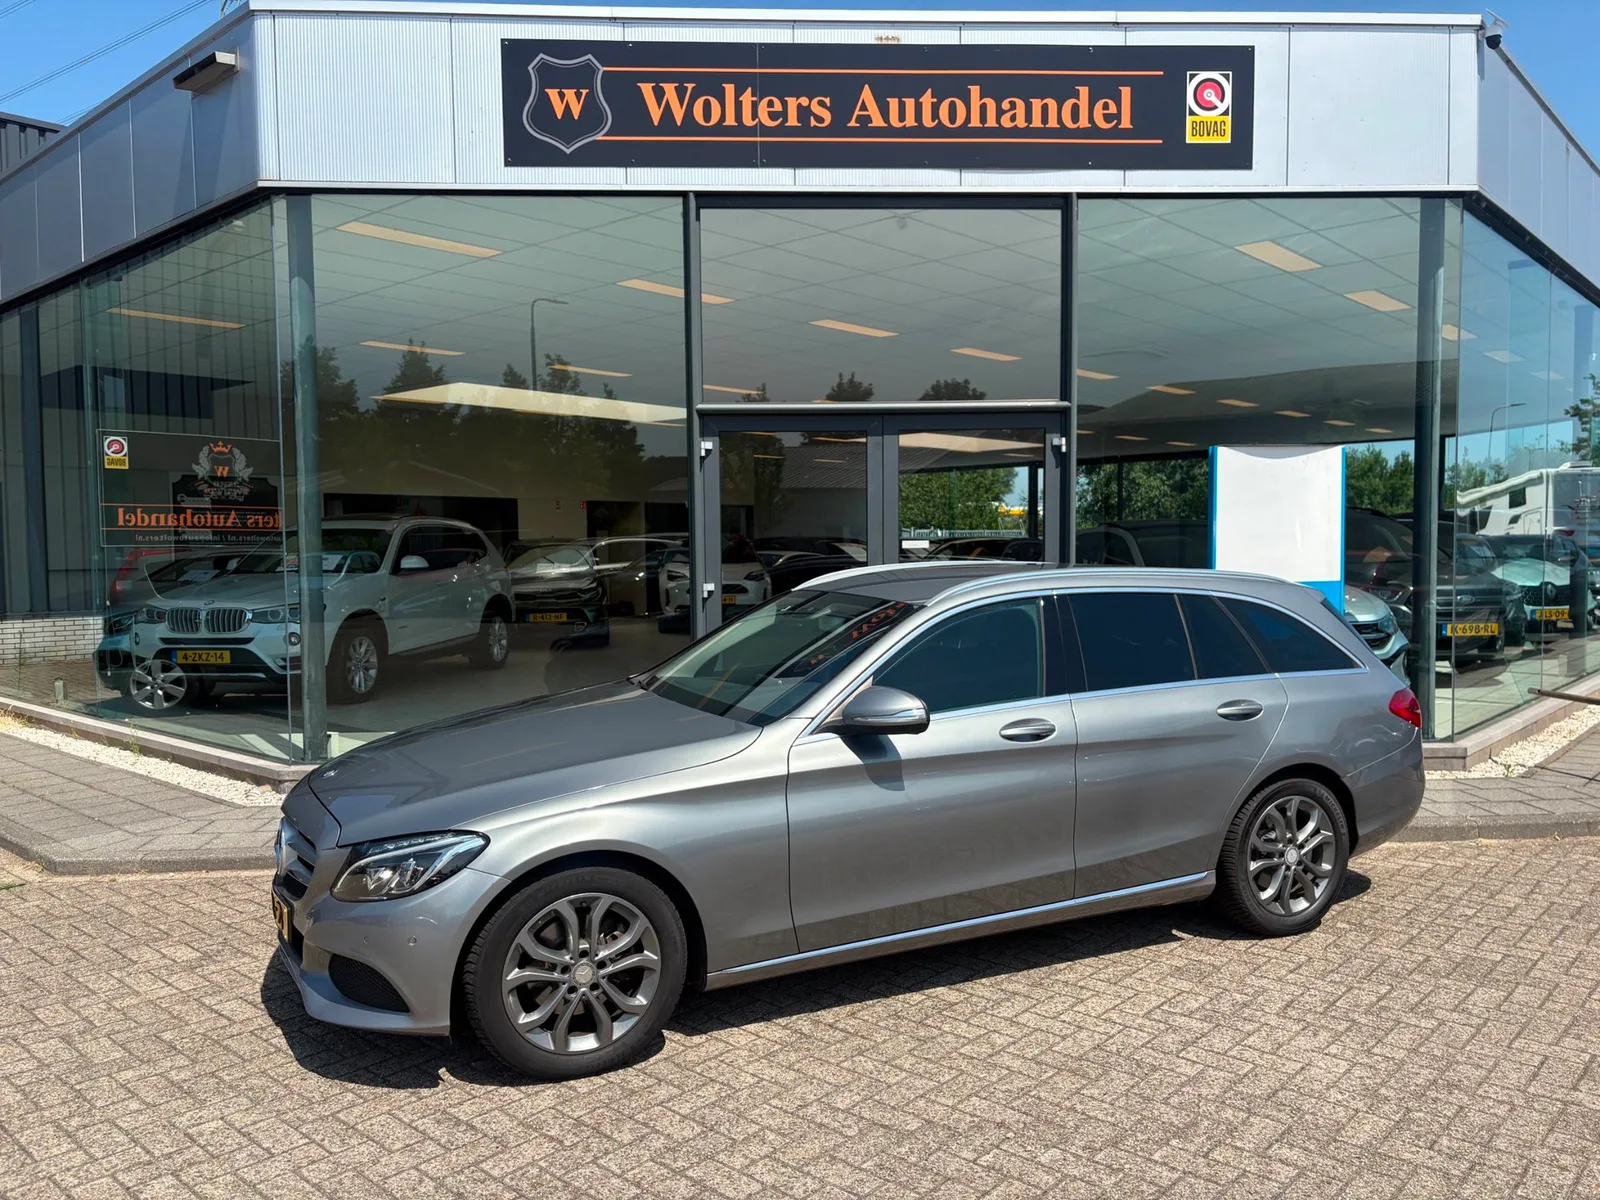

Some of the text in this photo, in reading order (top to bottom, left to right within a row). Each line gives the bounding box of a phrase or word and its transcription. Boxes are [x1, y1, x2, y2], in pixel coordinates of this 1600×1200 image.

[545, 89, 589, 120] W
[637, 82, 1133, 129] Wolters Autohandel
[1191, 120, 1226, 137] BOVAG
[182, 651, 224, 662] 4-ZKZ-14
